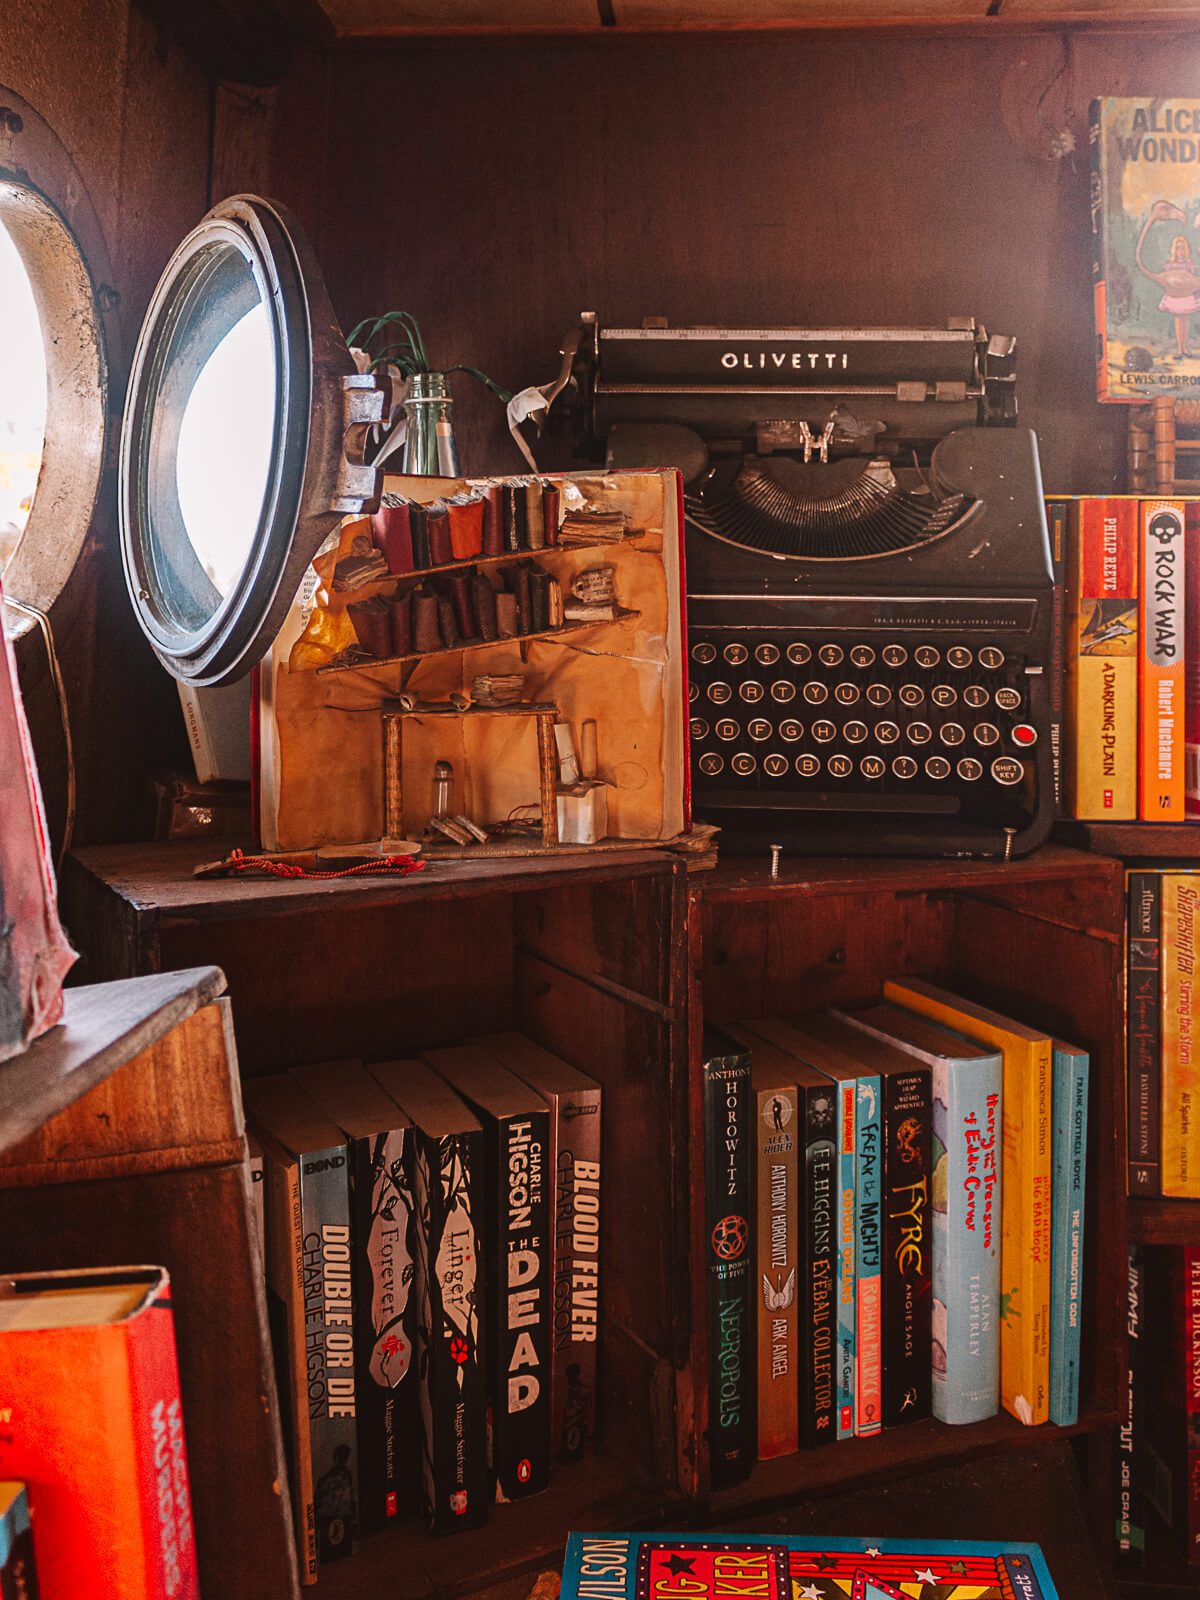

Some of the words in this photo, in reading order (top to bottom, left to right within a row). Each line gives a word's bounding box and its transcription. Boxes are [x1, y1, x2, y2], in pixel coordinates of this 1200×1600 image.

[1121, 137, 1200, 163] WOND
[720, 352, 848, 369] OLIVETTI
[1120, 374, 1155, 385] LEWIS
[1103, 517, 1117, 555] PHILIP
[1103, 557, 1117, 591] REEVE
[1154, 549, 1176, 605] ROCK
[1153, 609, 1176, 659] WAR
[1103, 663, 1115, 674] A
[713, 688, 724, 700] E
[746, 687, 757, 698] R
[777, 687, 788, 698] T
[811, 687, 820, 699] Y
[841, 689, 853, 700] U
[906, 690, 917, 702] O
[938, 691, 949, 703] P
[1101, 674, 1116, 731] DARKLING
[1157, 679, 1174, 715] Robert
[186, 701, 201, 750] LONGMANS
[691, 723, 702, 735] S
[722, 725, 734, 737] D
[755, 724, 766, 736] F
[786, 725, 797, 737] G
[817, 726, 829, 738] H
[851, 727, 859, 739] J
[881, 728, 892, 739] K
[914, 728, 925, 740] L
[1051, 723, 1060, 757] PHILIP
[707, 759, 717, 771] X
[739, 759, 749, 771] C
[771, 760, 781, 772] V
[803, 760, 813, 772] B
[834, 761, 846, 773] N
[866, 762, 879, 774] M
[995, 764, 1018, 773] SHIFT
[1103, 732, 1116, 777] PLAIN
[1157, 717, 1174, 780] Muchamore
[999, 772, 1016, 780] KEY
[1176, 979, 1193, 1017] Stirring
[1179, 1018, 1192, 1034] the
[1038, 1057, 1049, 1114] Francesca
[1075, 1076, 1084, 1108] FRANK
[1140, 1073, 1149, 1105] DAVID
[724, 1081, 740, 1195] HOROWITZ
[766, 1132, 791, 1146] ALEX
[963, 1112, 978, 1126] of
[979, 1093, 999, 1151] Harry
[1038, 1117, 1048, 1156] Simon
[1073, 1110, 1083, 1159] COTTRELL
[1179, 1104, 1191, 1135] Sparkes
[304, 1156, 346, 1177] BOND
[763, 1142, 793, 1155] RIDER
[860, 1122, 880, 1176] FREAK
[964, 1129, 981, 1175] Eddie
[291, 1182, 299, 1200] THE
[507, 1121, 532, 1231] HIGSON
[529, 1142, 542, 1204] CHARLIE
[770, 1164, 787, 1213] ANTHONY
[1033, 1176, 1043, 1198] BIG
[1072, 1160, 1082, 1192] BOYCE
[292, 1202, 301, 1231] QUEST
[556, 1149, 574, 1250] CHARLIE
[572, 1159, 600, 1254] BLOOD
[813, 1179, 830, 1255] HIGGINS
[842, 1188, 854, 1245] ODIOUS
[963, 1175, 982, 1232] Carver
[981, 1168, 998, 1250] Treasure
[1033, 1201, 1043, 1227] BAD
[1071, 1208, 1081, 1228] THE
[294, 1234, 302, 1253] FOR
[507, 1236, 541, 1252] THE
[771, 1213, 788, 1269] HOROWITZ
[859, 1201, 880, 1267] MIGHTY
[295, 1257, 304, 1289] OLWEN
[302, 1231, 325, 1326] CHARLIE
[320, 1224, 353, 1327] DOUBLE
[380, 1226, 399, 1315] Forever
[445, 1229, 470, 1305] Linger
[717, 1271, 728, 1280] OF
[841, 1247, 854, 1304] OCEANS
[1069, 1230, 1081, 1300] UNFORGOTTEN
[554, 1256, 573, 1353] HIGSON
[571, 1259, 599, 1343] FEVER
[812, 1258, 831, 1326] EYEBALL
[861, 1283, 879, 1341] RODMAN
[905, 1283, 913, 1321] ANGIE
[1127, 1255, 1139, 1339] JIMMY
[507, 1249, 542, 1415] DEAD
[772, 1318, 788, 1343] ARK
[969, 1274, 980, 1357] TEMPERLEY
[981, 1293, 992, 1333] ALAN
[1068, 1302, 1078, 1328] COAT
[324, 1332, 355, 1369] OR
[772, 1343, 788, 1380] ANGEL
[842, 1339, 853, 1365] ANITA
[905, 1325, 913, 1358] SAGE
[1191, 1314, 1200, 1398] DICKINSON
[304, 1329, 326, 1420] HIGSON
[718, 1295, 745, 1429] NECROPOLIS
[813, 1326, 832, 1414] COLLECTOR
[861, 1341, 879, 1398] PHILBRICK
[327, 1377, 356, 1419] DIE
[384, 1399, 394, 1436] Maggie
[454, 1401, 465, 1438] Maggie
[1121, 1461, 1130, 1488] JOE
[1120, 1491, 1131, 1535] CRAIG
